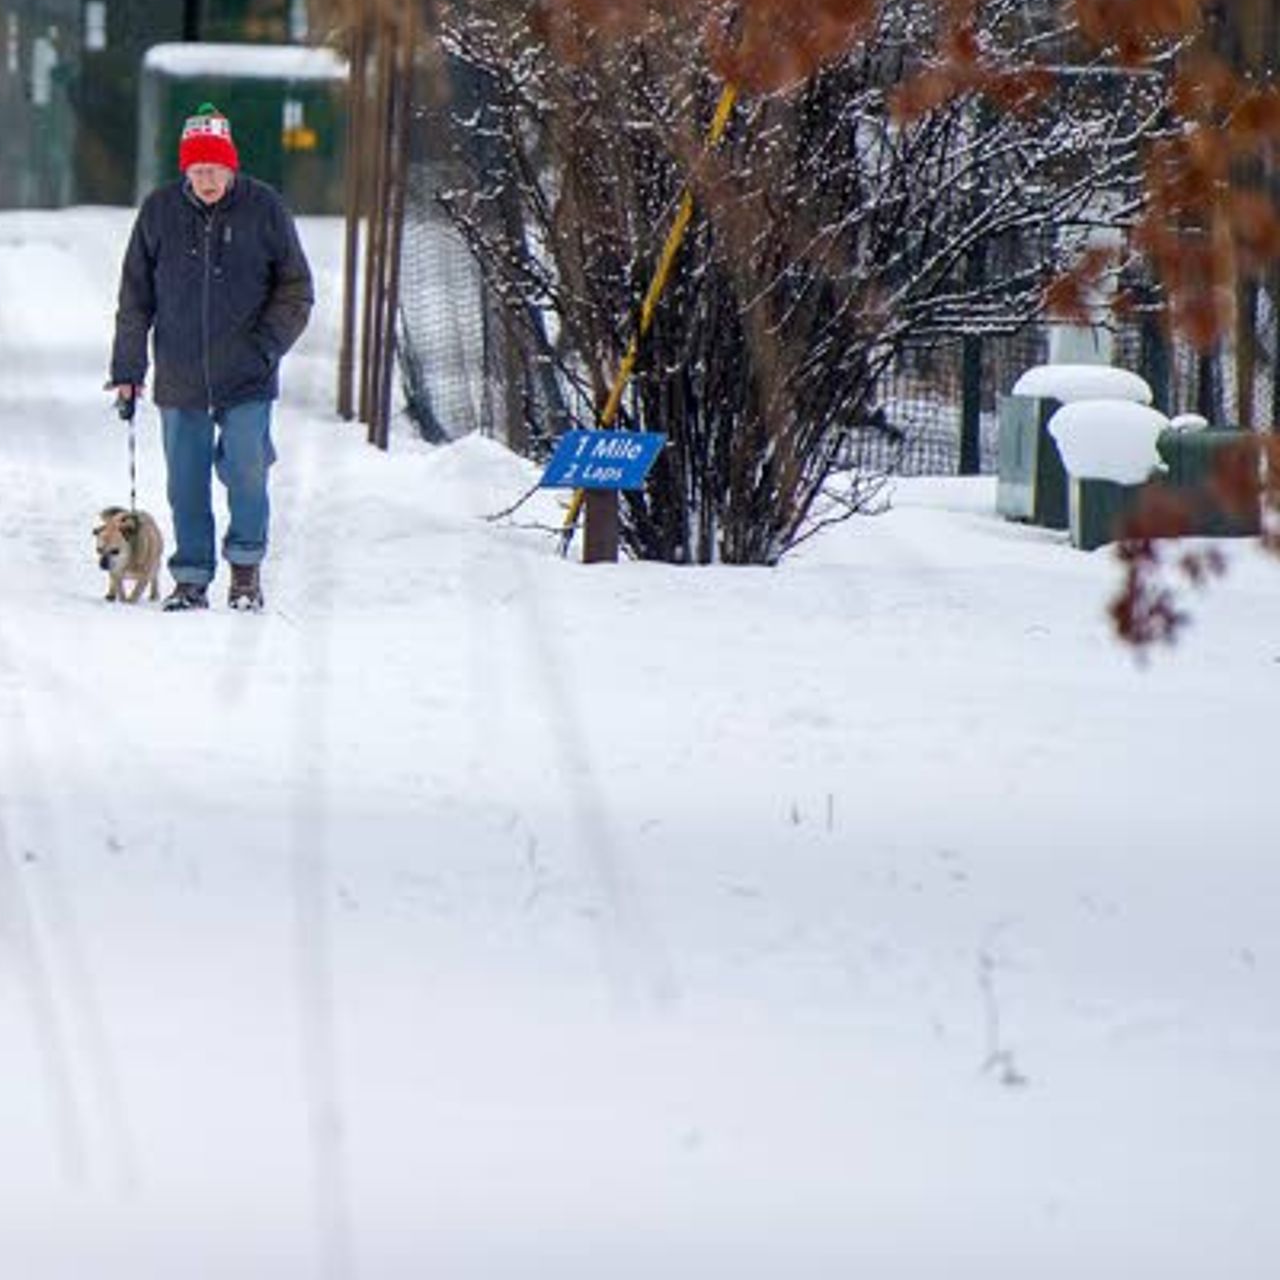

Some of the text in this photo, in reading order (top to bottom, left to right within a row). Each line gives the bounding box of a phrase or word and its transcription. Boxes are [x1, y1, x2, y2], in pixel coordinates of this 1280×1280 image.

[576, 436, 643, 459] 1 Mile
[563, 463, 624, 481] 2 Laps
